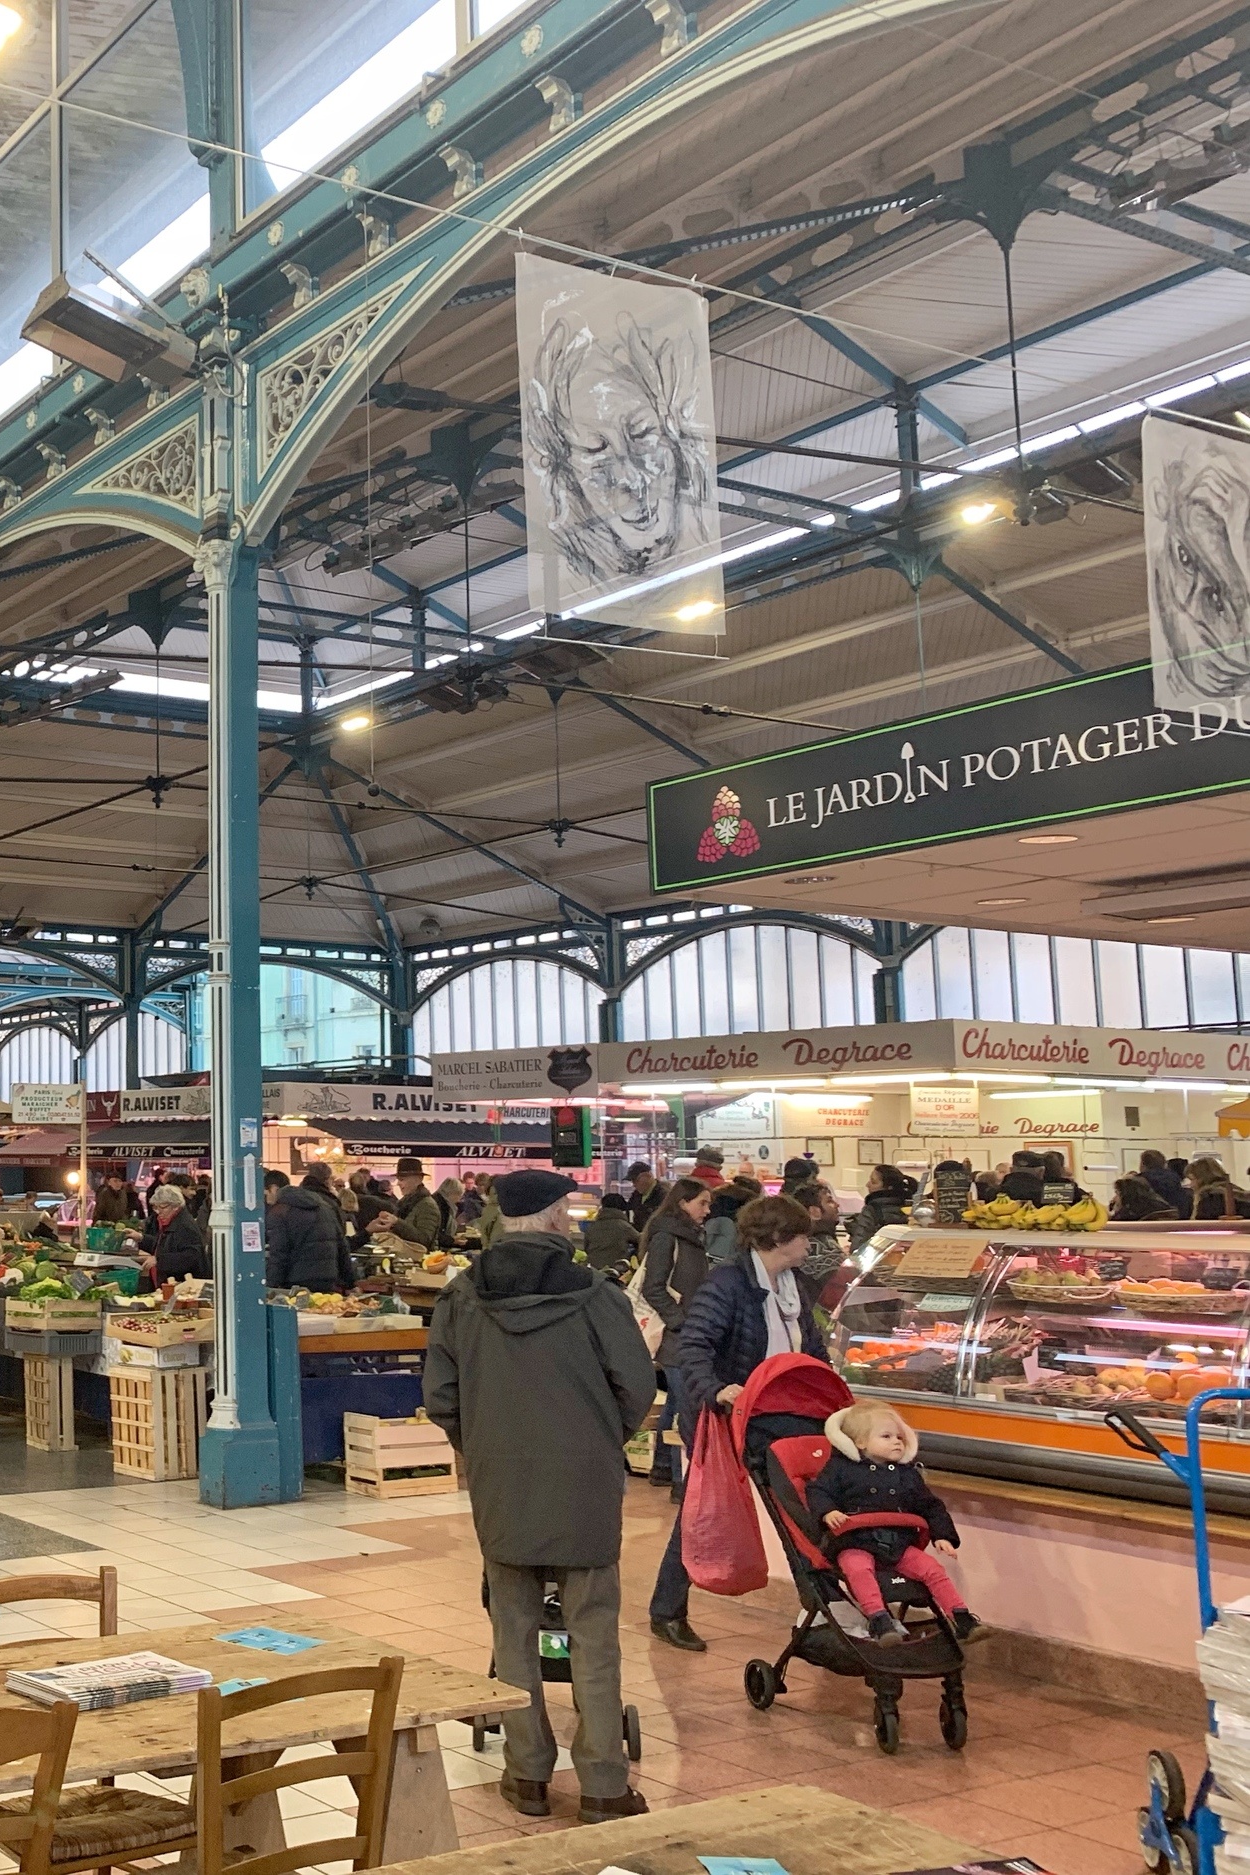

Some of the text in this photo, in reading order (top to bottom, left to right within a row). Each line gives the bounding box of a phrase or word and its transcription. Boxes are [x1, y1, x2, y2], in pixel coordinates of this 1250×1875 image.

[767, 790, 806, 829] LE
[811, 745, 951, 830] JARDIN
[961, 712, 1179, 788] POTAGER
[625, 1038, 913, 1075] Charcuterie Degrace
[962, 1027, 1090, 1066] Charcuterie
[1108, 1038, 1205, 1075] Degrace
[437, 1061, 482, 1076] MARCEL
[485, 1058, 542, 1073] SABATIER
[437, 1078, 480, 1092] Boucherie
[490, 1076, 543, 1091] Charcuterie
[122, 1095, 181, 1111] R.ALVISET
[817, 1108, 870, 1117] CHARCUTERIE
[825, 1118, 865, 1126] DEGRACE
[1014, 1117, 1100, 1136] Degrace
[112, 1146, 155, 1157] ALVISET
[163, 1147, 205, 1157] Charcuterie
[347, 1144, 412, 1155] Boucherie
[456, 1146, 523, 1158] ALVIET
